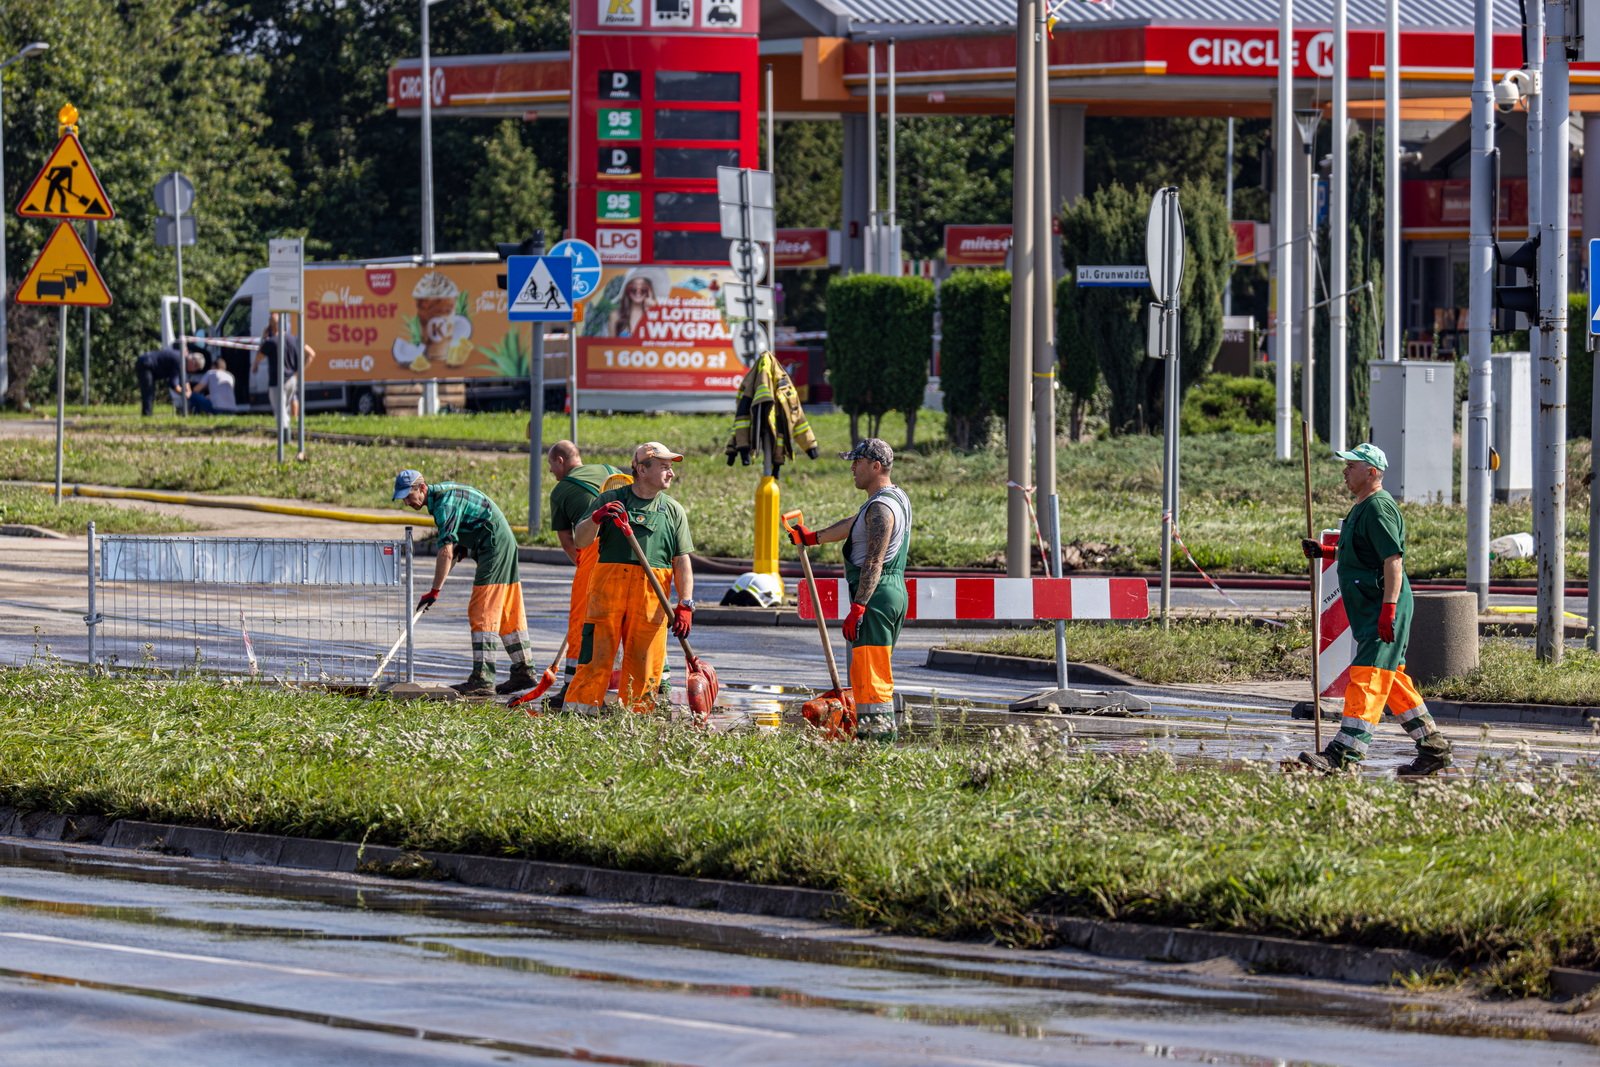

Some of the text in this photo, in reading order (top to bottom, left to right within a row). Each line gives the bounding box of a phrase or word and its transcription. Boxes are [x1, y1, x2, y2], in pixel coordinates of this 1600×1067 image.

[400, 76, 422, 99] CIRC
[612, 72, 628, 88] D
[608, 111, 632, 127] 95
[612, 149, 628, 166] D
[606, 194, 631, 210] 95
[599, 233, 638, 249] LPG
[1080, 269, 1150, 279] ul. Grunwaldzk
[307, 300, 398, 319] Summer
[647, 307, 721, 321] w LOTERII
[328, 323, 378, 345] Stop
[647, 321, 735, 339] WYGRAJ
[329, 358, 360, 369] CIRCLE
[604, 350, 727, 368] 1 600 000 zł
[1323, 587, 1341, 604] TRAFF
